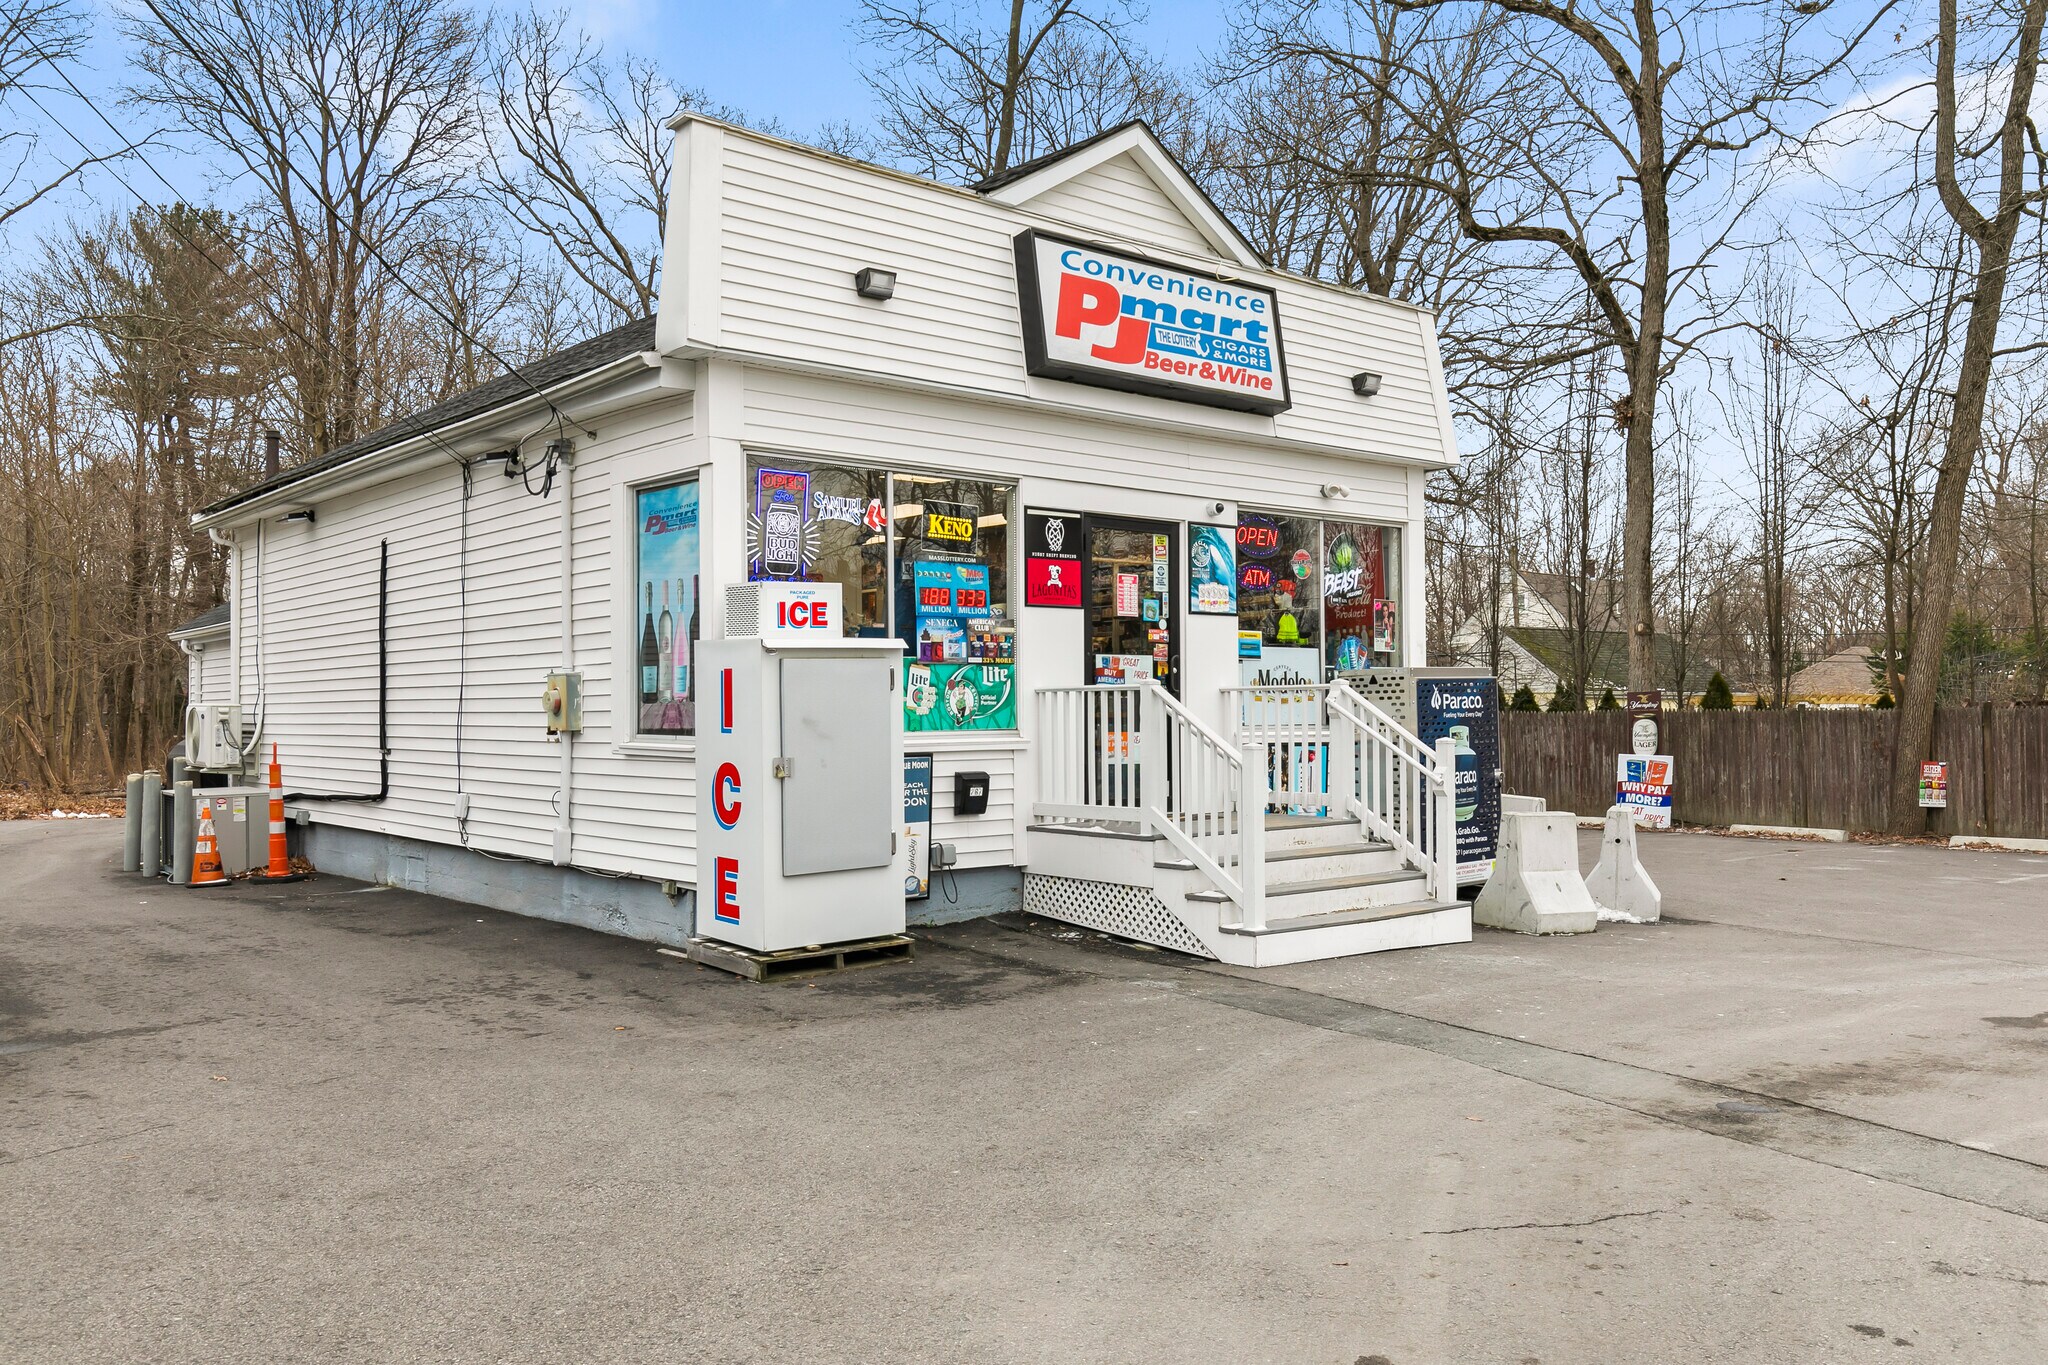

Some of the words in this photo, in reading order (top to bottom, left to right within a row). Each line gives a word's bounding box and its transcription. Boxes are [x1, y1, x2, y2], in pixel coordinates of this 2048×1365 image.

[1060, 250, 1266, 314] Convenience
[1120, 294, 1269, 344] mart
[1158, 330, 1171, 344] THE
[1171, 332, 1197, 349] LOTTERY
[1212, 339, 1266, 358] CIGARS
[762, 473, 806, 490] OPEN
[773, 490, 795, 502] For
[814, 491, 865, 514] SAMUEL
[649, 501, 697, 515] Convenience
[662, 508, 697, 521] mart
[817, 507, 861, 526] ADAMS
[928, 514, 973, 537] KENO
[770, 536, 797, 549] BUD
[1236, 526, 1278, 547] OPEN
[928, 555, 977, 563] MASSLOTTERY.COM
[1244, 569, 1271, 586] ATM
[1324, 566, 1363, 597] BEAST
[924, 588, 950, 606] 188
[957, 589, 986, 607] 333
[1032, 584, 1077, 599] LAGUNITAS
[777, 601, 828, 629] ICE
[1335, 609, 1367, 619] Product!
[925, 619, 958, 627] SENECA
[1123, 657, 1140, 667] GREAT
[911, 672, 928, 687] Lite
[981, 665, 1008, 687] Lite
[1097, 676, 1125, 684] AMERICAN
[1134, 670, 1149, 680] PRICE
[1258, 669, 1306, 694] Modelo
[912, 761, 929, 770] MOON
[1455, 770, 1477, 785] araco
[912, 788, 929, 796] THE
[1622, 782, 1647, 792] WHY
[1647, 785, 1668, 795] PAY
[904, 797, 927, 806] OON
[1625, 793, 1663, 806] MORE?
[1463, 846, 1491, 856] paracogas.com
